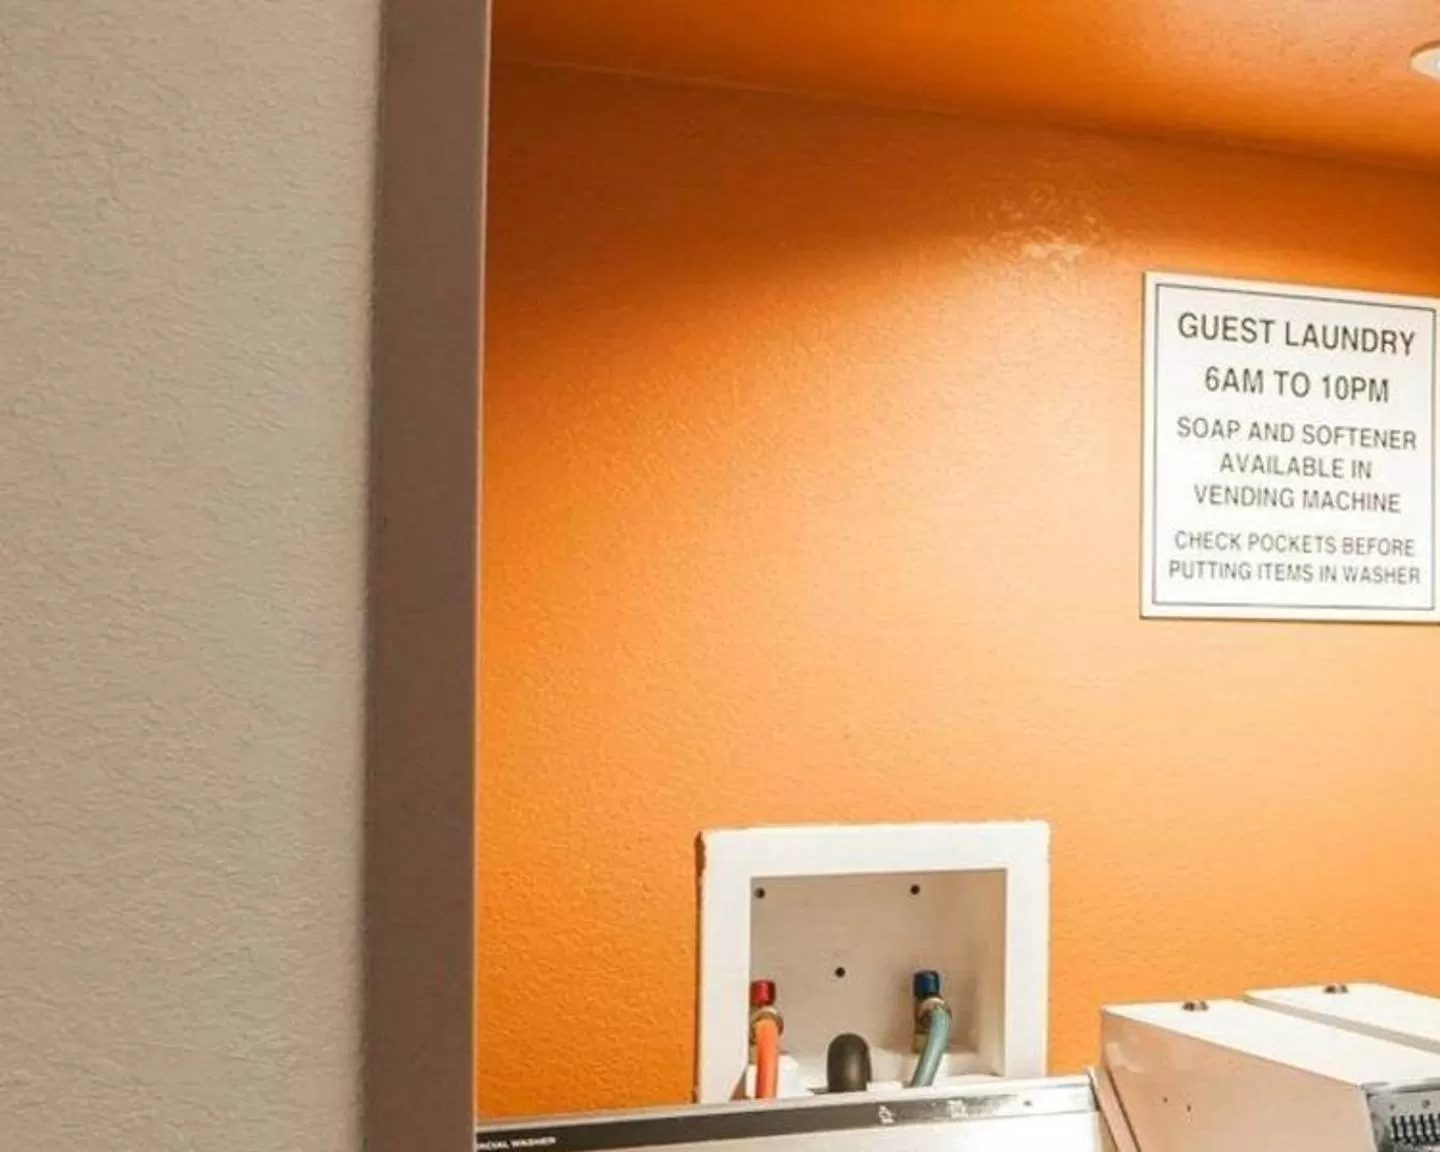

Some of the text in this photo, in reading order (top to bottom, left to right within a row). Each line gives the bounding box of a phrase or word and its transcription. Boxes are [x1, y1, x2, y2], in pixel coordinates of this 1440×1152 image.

[1178, 312, 1416, 357] GUEST LAUNDRY
[1204, 366, 1389, 403] 6AM TO 10PM
[1177, 416, 1417, 450] SOAP AND SOFTENER
[1220, 452, 1372, 479] AVAILABLE IN
[1194, 484, 1401, 513] VENDING MACHINE
[1174, 530, 1415, 557] CHECK POCKETS BEFORE
[1169, 560, 1420, 585] PUTTING ITEMS IN WASHER
